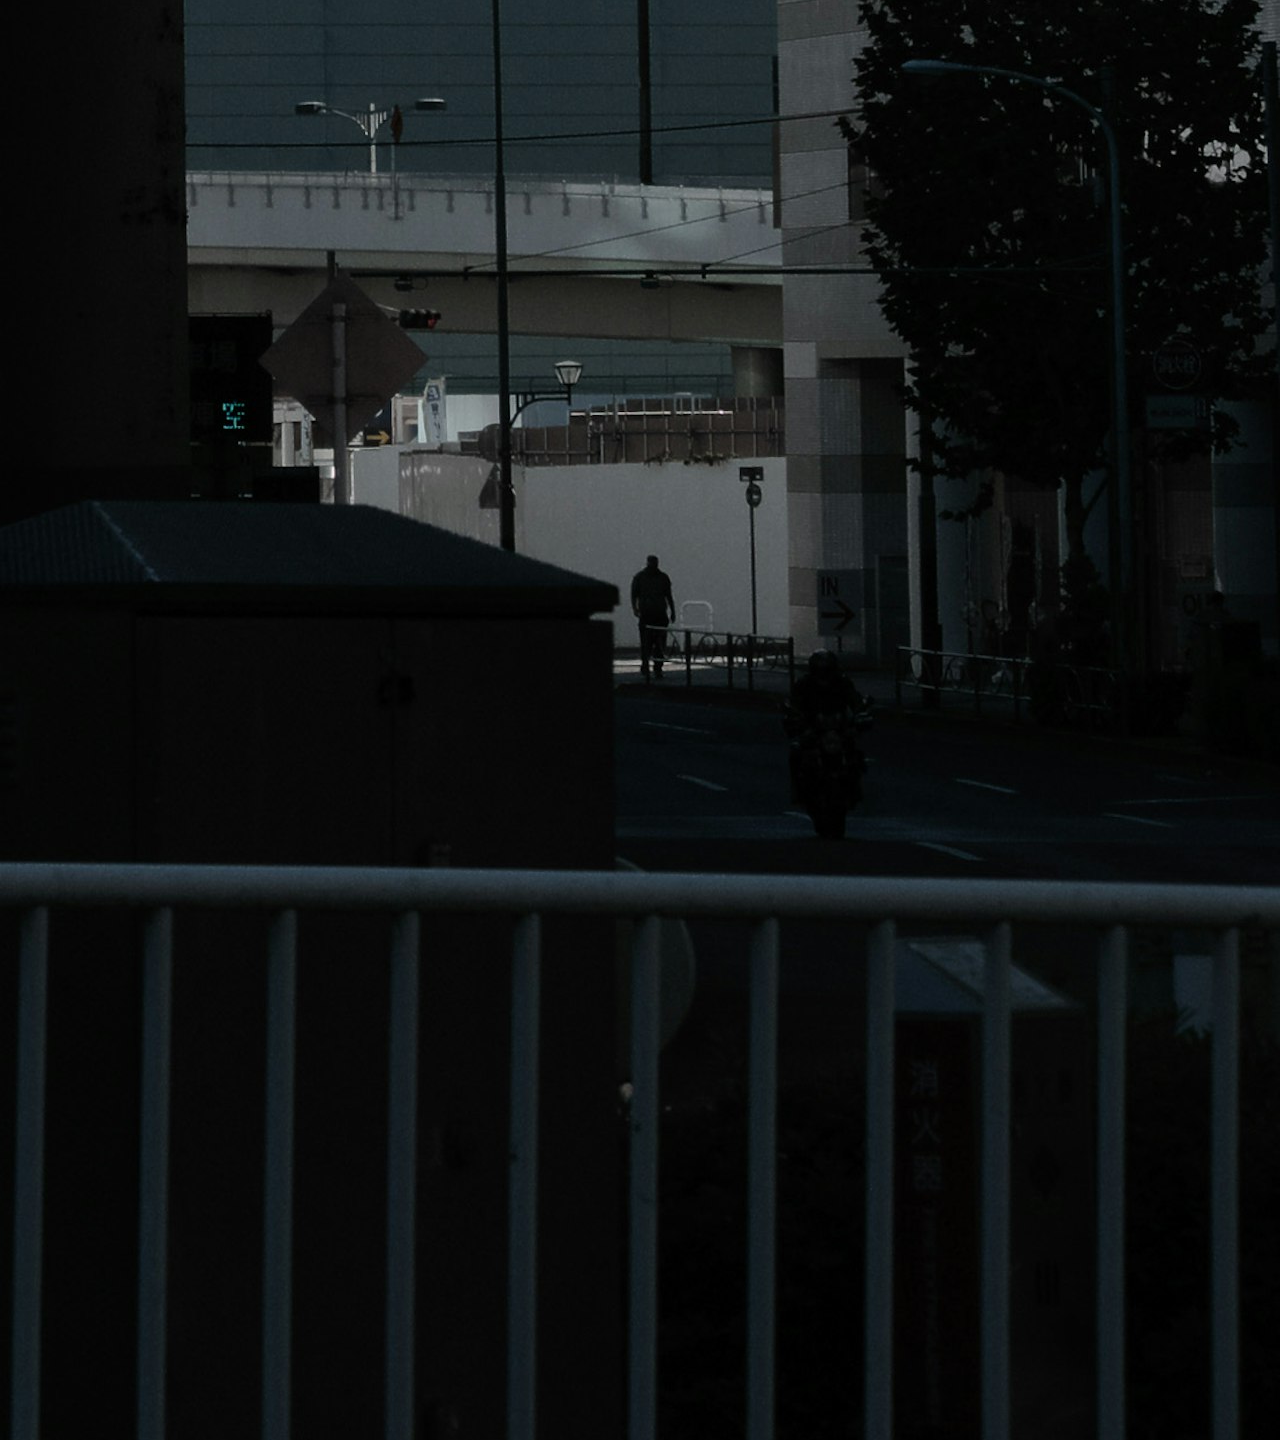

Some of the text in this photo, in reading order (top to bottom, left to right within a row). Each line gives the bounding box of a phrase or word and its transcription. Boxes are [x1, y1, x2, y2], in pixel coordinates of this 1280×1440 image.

[821, 576, 839, 596] IN
[910, 1059, 942, 1191] 消火器
